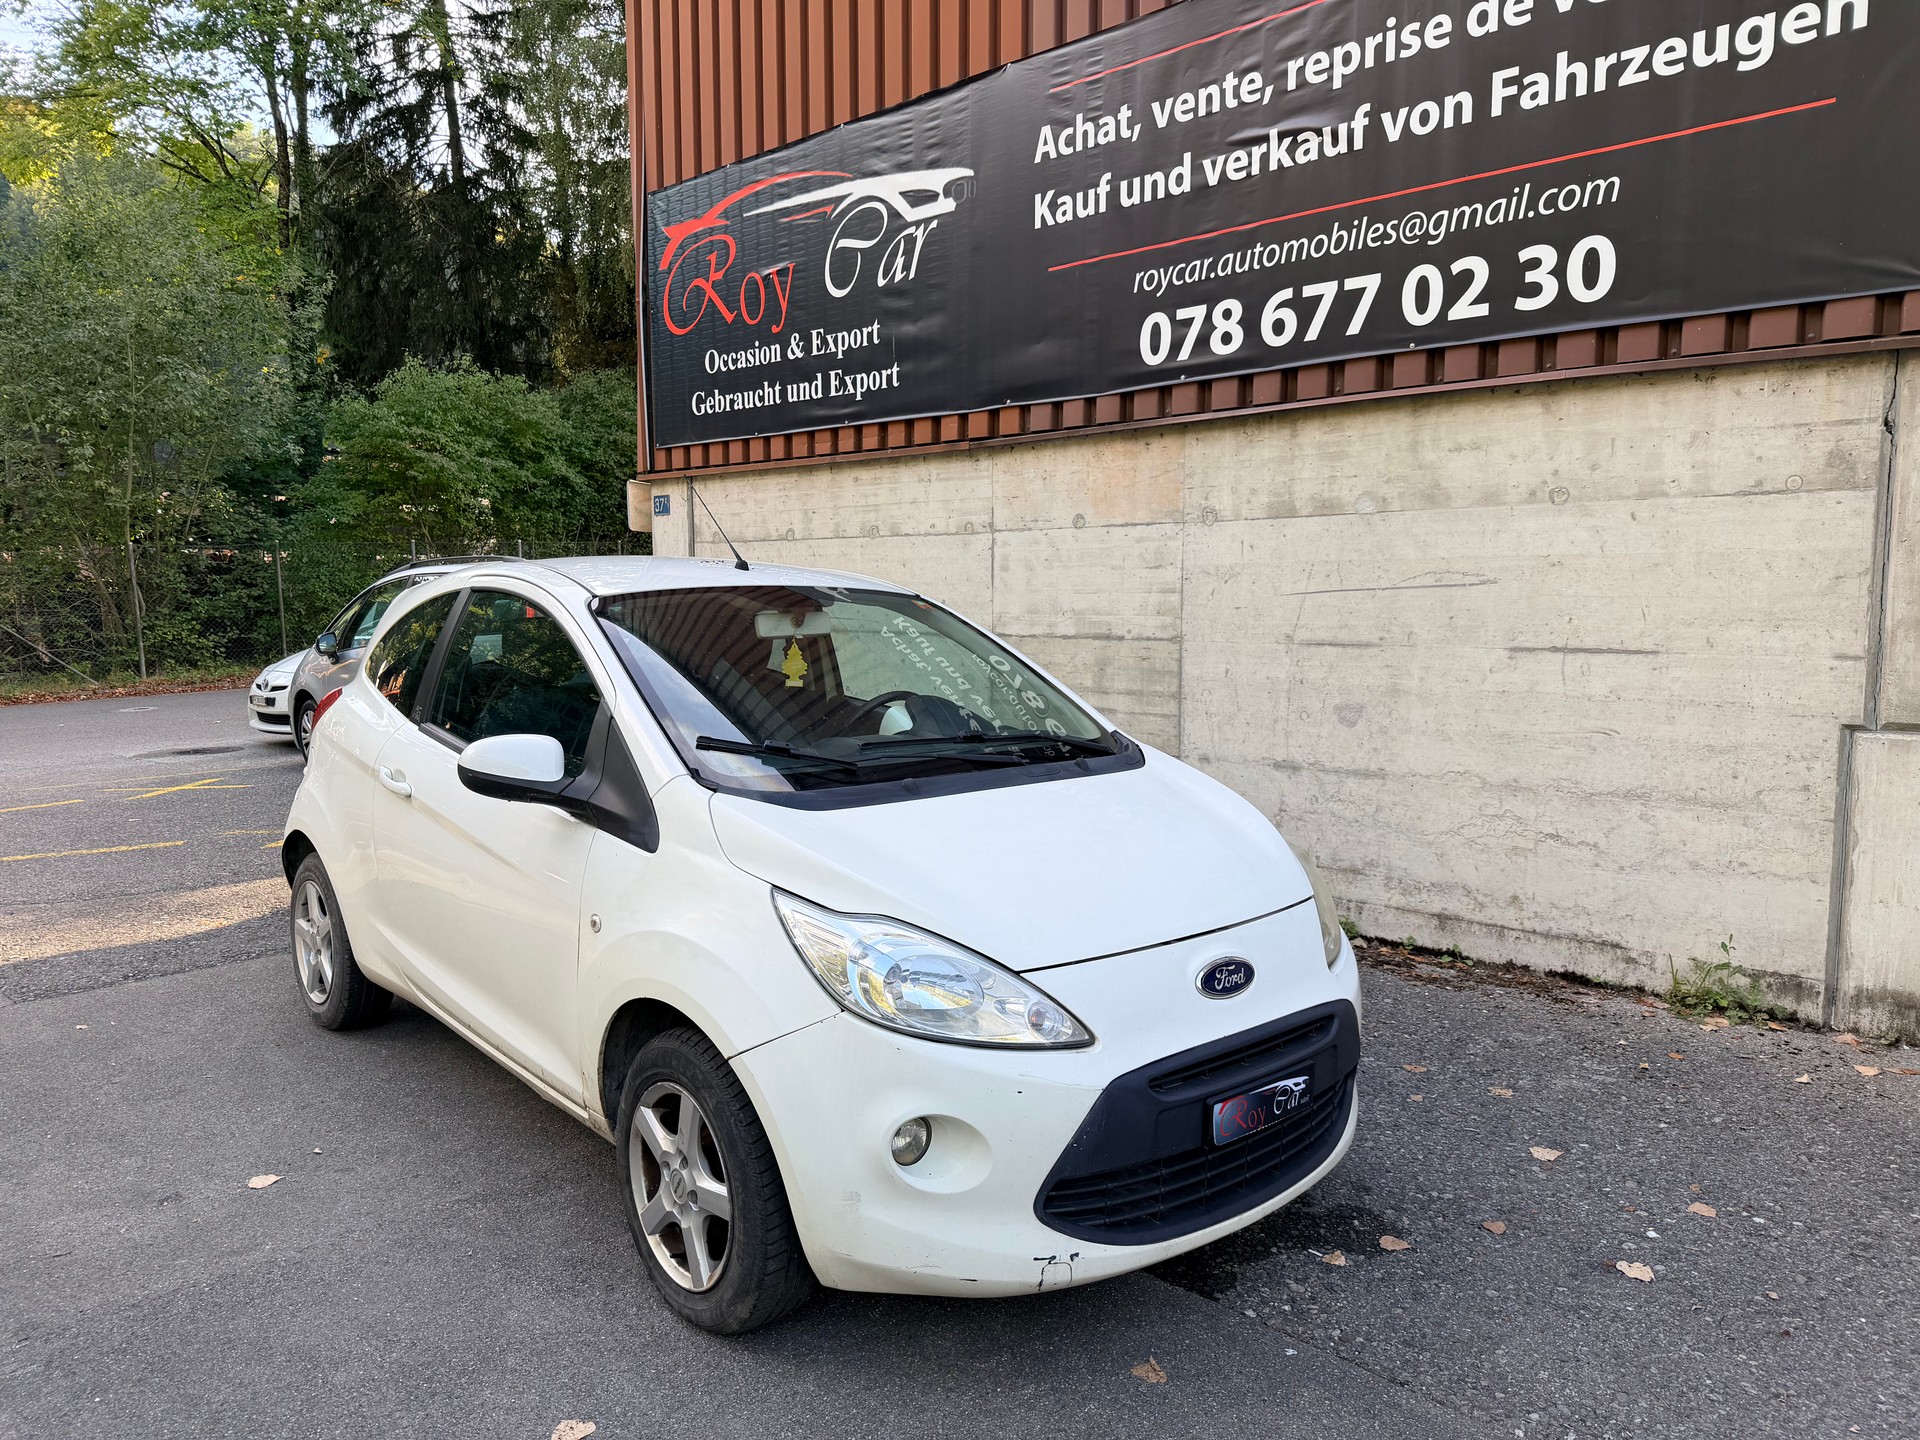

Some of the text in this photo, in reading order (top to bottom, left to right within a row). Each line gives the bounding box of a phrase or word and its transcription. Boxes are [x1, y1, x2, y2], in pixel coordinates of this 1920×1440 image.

[1034, 0, 1534, 164] Achat, vente, reprise de
[1034, 0, 1869, 230] Kauf und verkauf von Fahrzeugen
[663, 200, 938, 335] Roy Car
[1133, 176, 1621, 297] roycar.automobiles@gmail.com
[704, 318, 881, 374] Occasion & Export
[1139, 234, 1617, 366] 078 677 02 30
[691, 361, 900, 416] Gebraucht und Export
[1214, 964, 1246, 990] Ford
[1220, 1084, 1302, 1136] Roy Car
